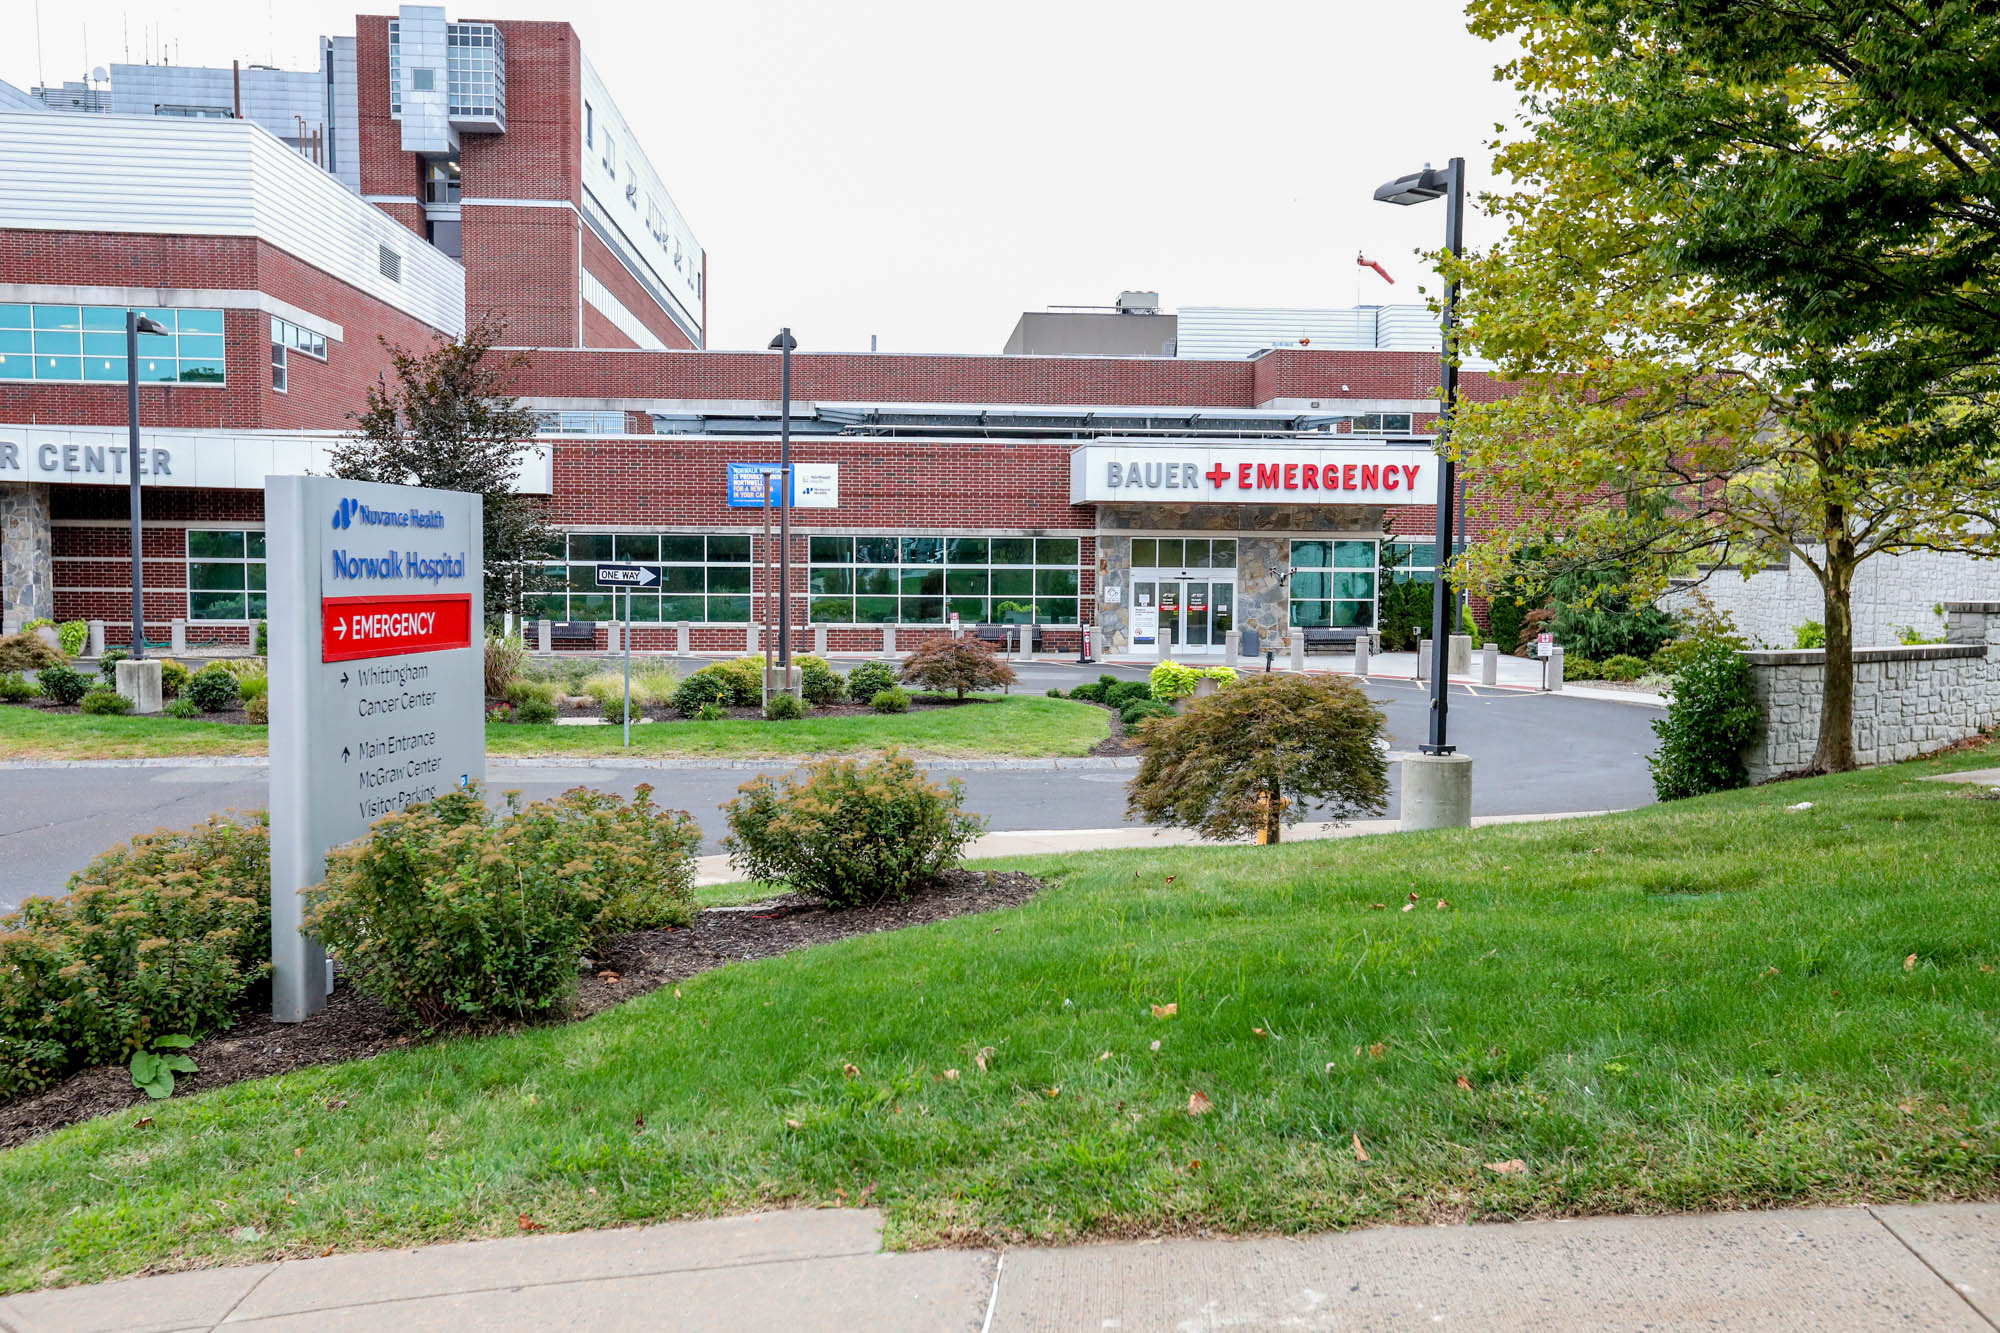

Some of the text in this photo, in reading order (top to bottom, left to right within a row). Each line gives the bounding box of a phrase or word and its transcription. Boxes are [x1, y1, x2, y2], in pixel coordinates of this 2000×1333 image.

[1106, 461, 1421, 491] BAUER EMERGENCY
[360, 505, 445, 529] Nuvance Health
[332, 549, 465, 585] Norwalk Hospital
[601, 570, 640, 580] ONE WAY
[352, 611, 436, 640] EMERGENCY
[358, 663, 429, 687] Whittingham
[358, 690, 437, 717] Cancer Center
[359, 731, 436, 761] Main Entrance
[359, 757, 442, 790] McGraw Center
[359, 784, 437, 819] Visitor Parking
